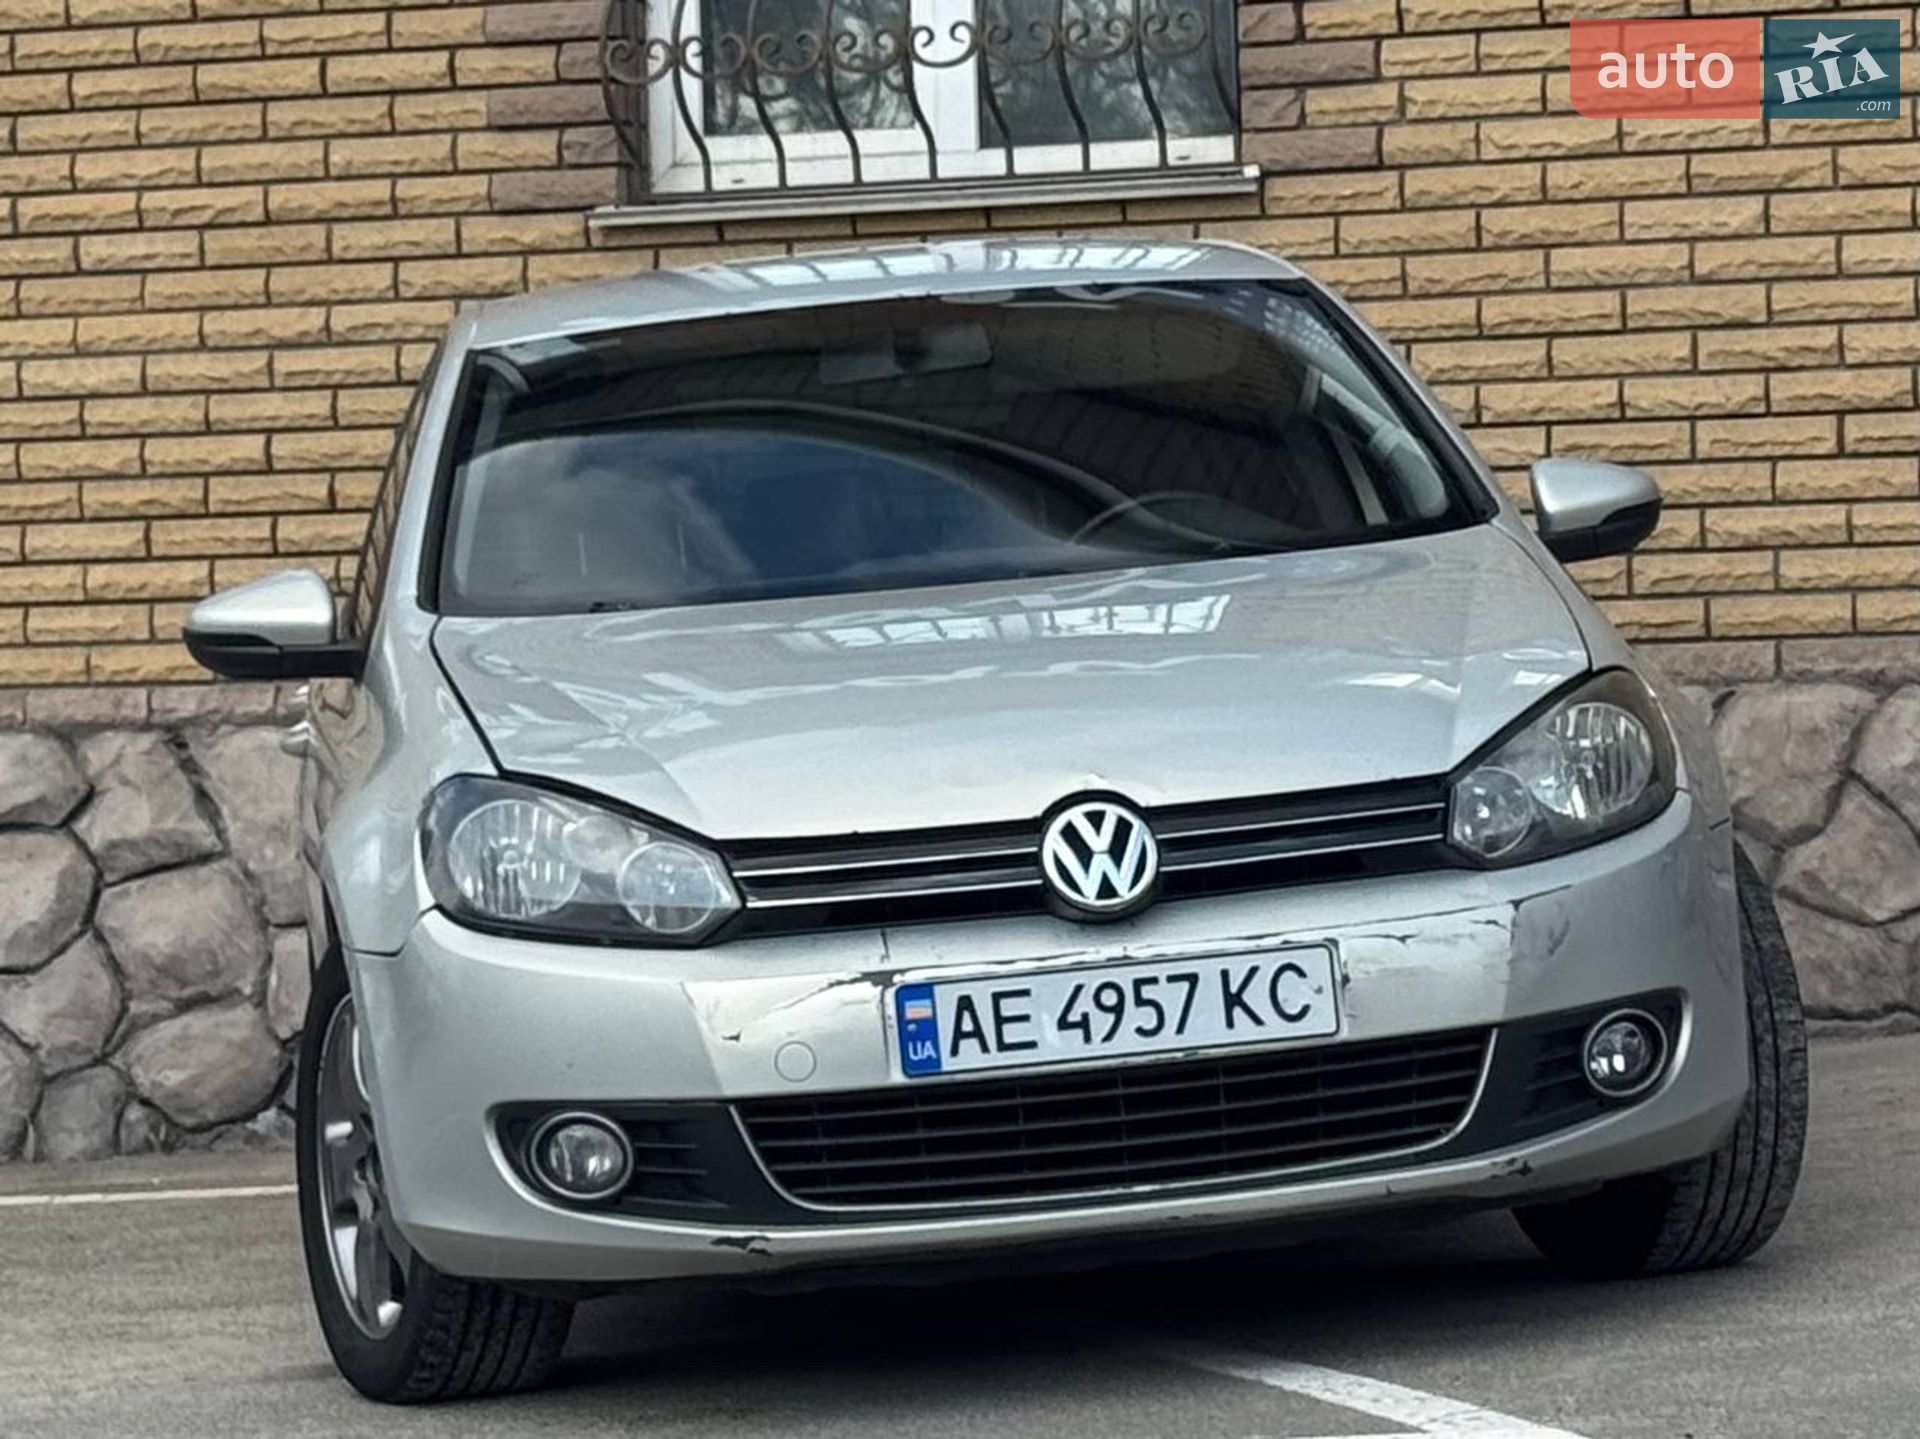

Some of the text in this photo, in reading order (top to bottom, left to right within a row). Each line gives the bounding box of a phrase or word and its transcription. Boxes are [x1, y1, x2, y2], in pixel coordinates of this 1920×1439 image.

[1046, 805, 1152, 904] VW
[908, 1041, 937, 1062] UA
[949, 962, 1312, 1057] AE 4957 KC
